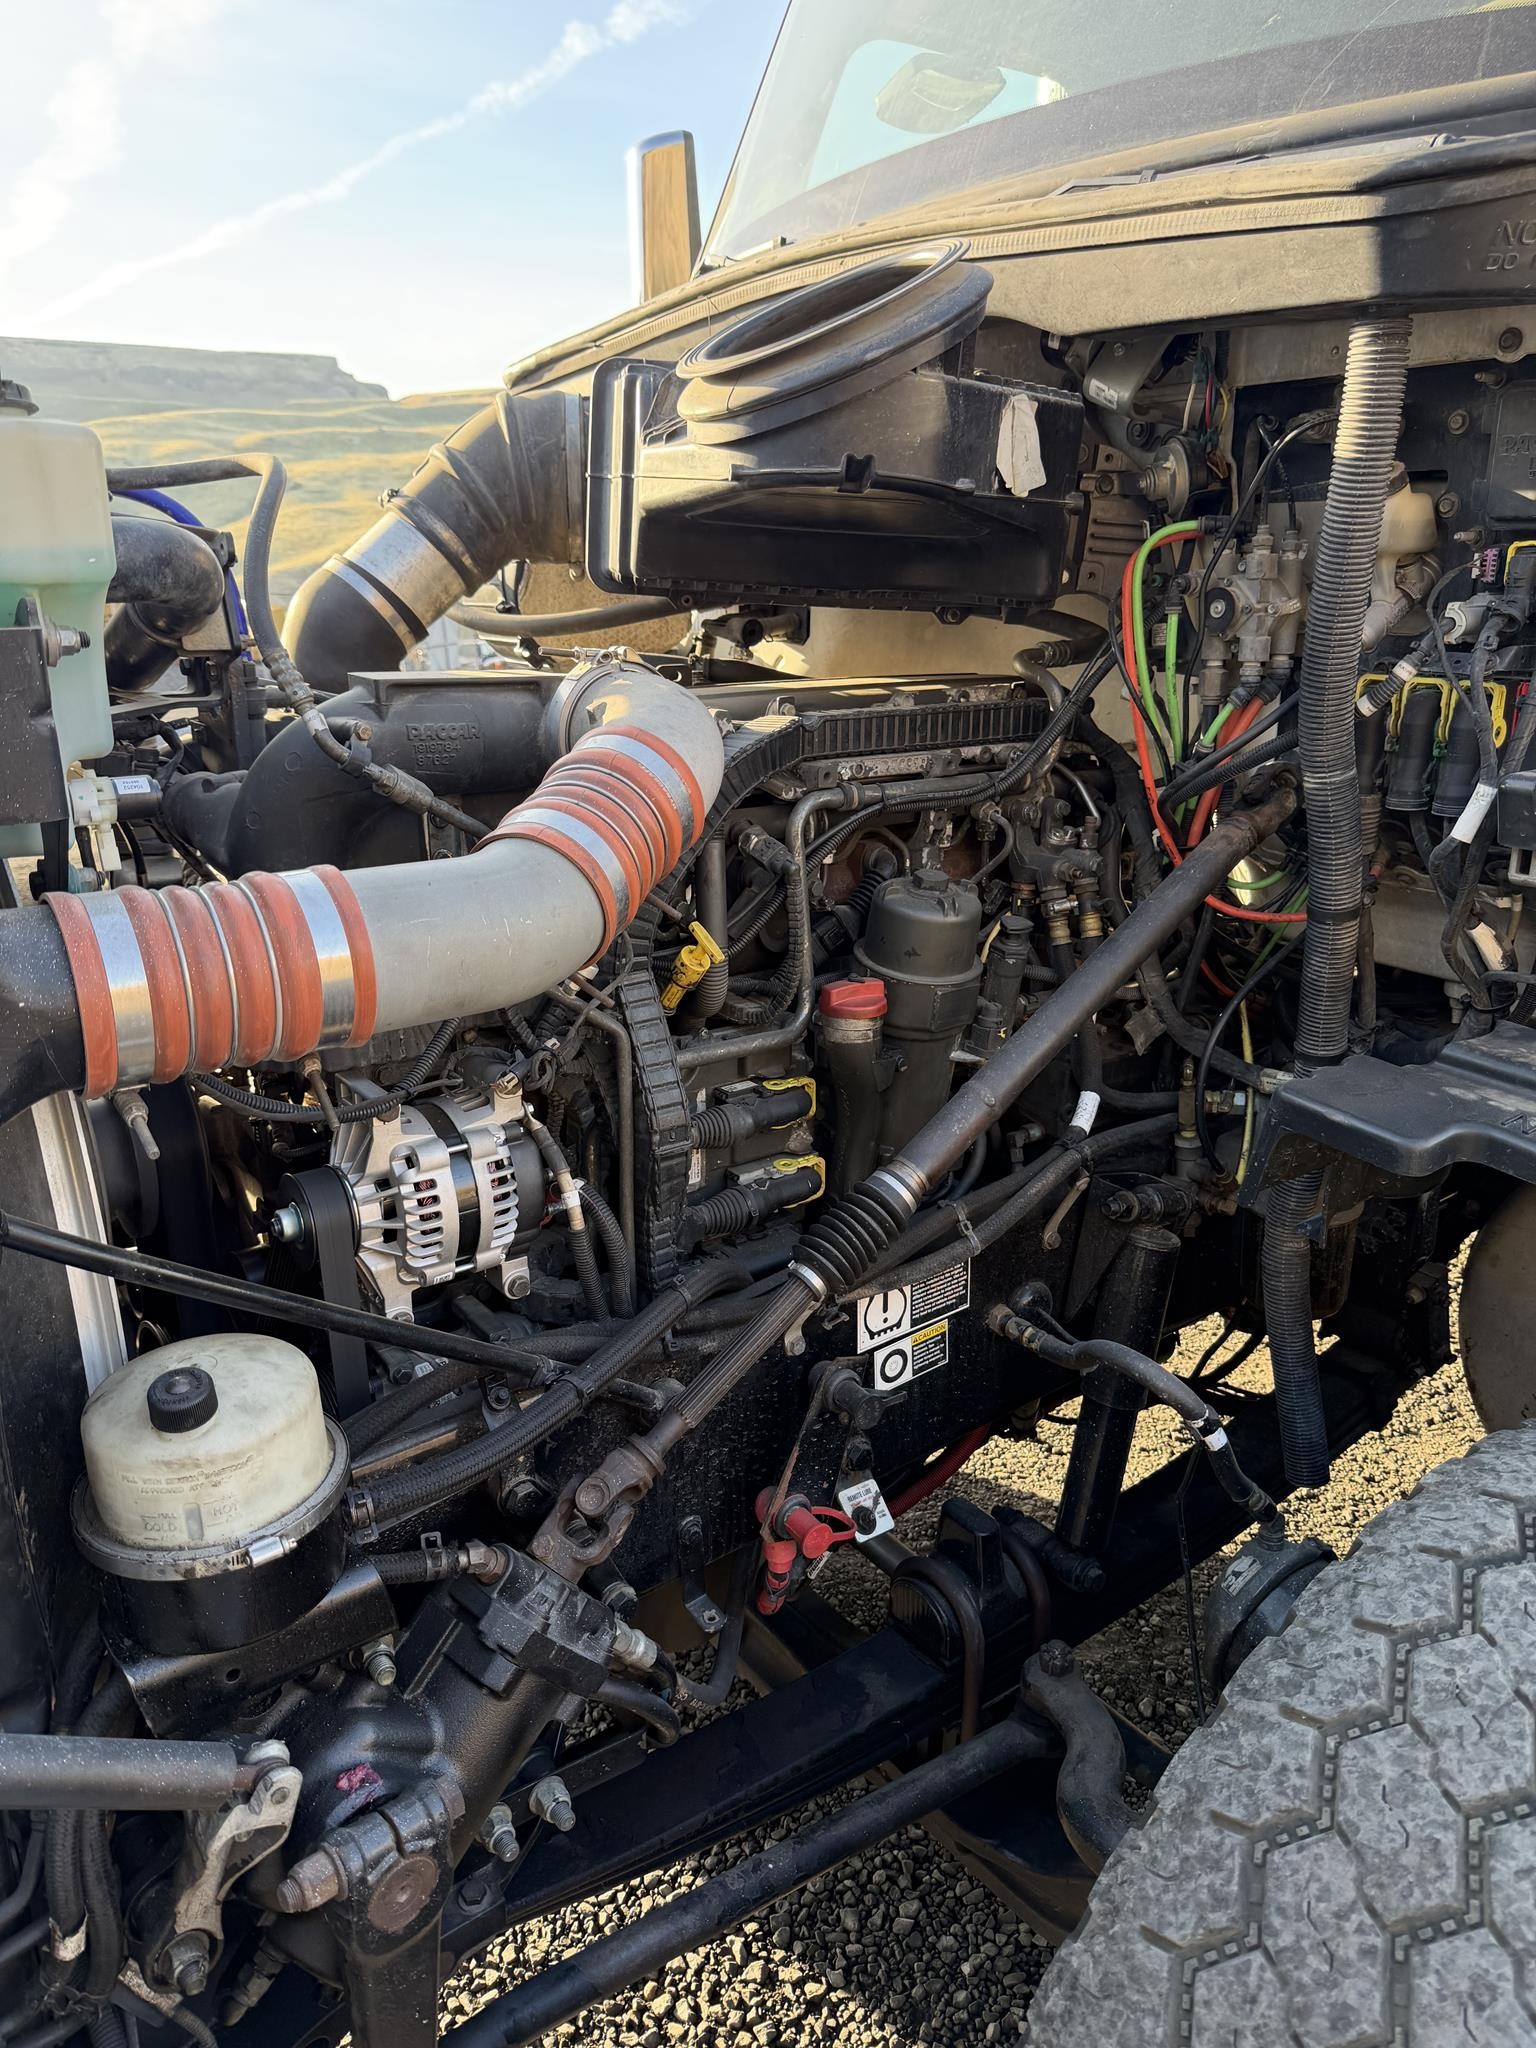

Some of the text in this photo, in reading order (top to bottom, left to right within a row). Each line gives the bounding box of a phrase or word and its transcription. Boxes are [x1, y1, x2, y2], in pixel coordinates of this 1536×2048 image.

[1484, 252, 1519, 271] DO
[405, 723, 480, 741] PACCAR
[918, 1324, 946, 1342] CAUTION
